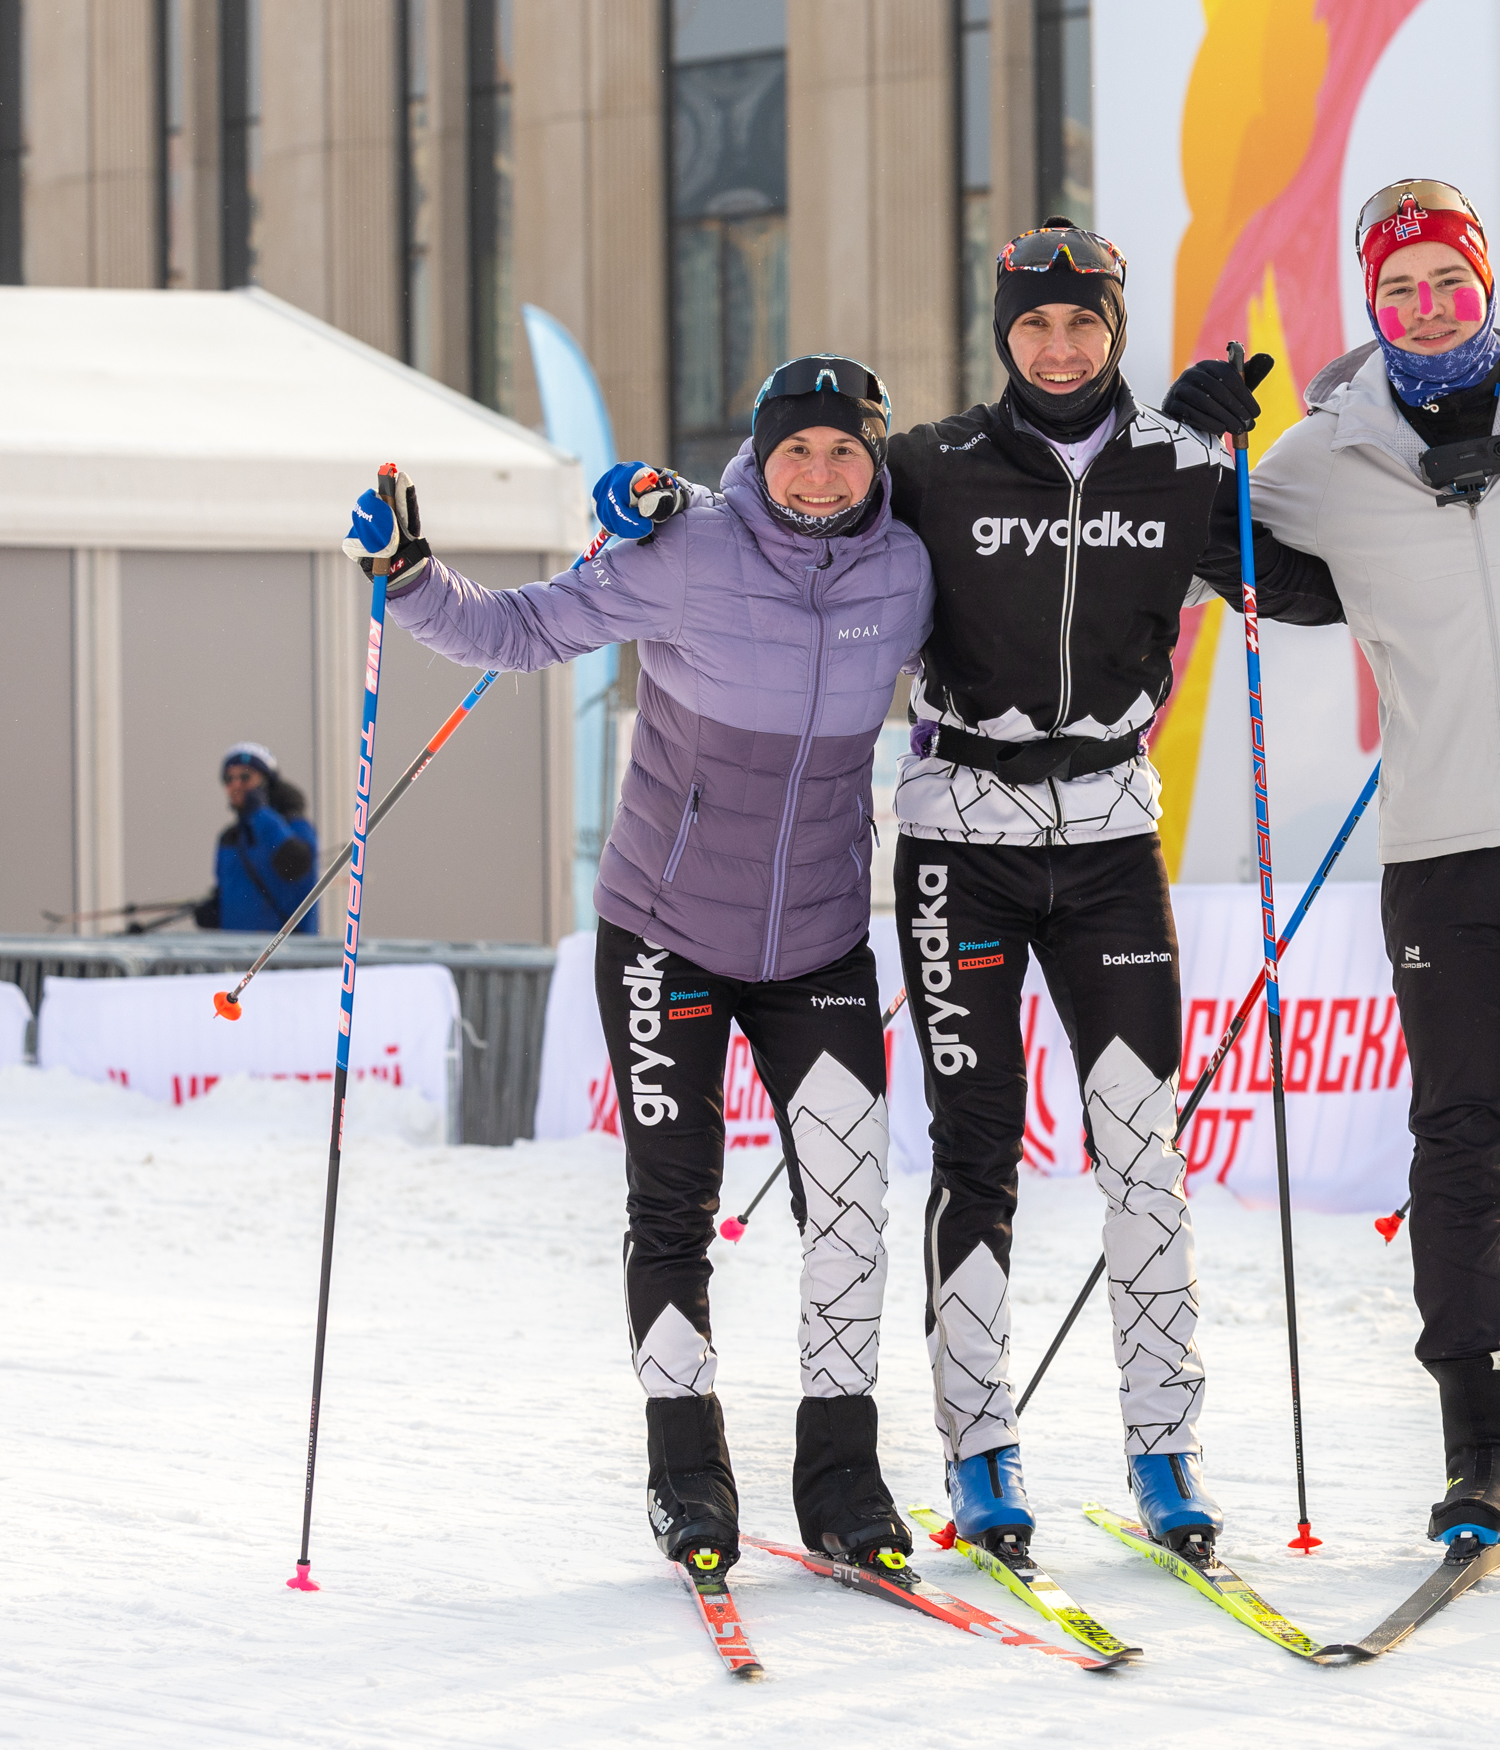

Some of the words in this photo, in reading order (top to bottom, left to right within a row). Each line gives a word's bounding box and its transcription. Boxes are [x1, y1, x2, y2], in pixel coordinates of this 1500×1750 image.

[972, 511, 1165, 556] gryadka
[838, 624, 879, 640] MOAX
[959, 940, 1000, 951] Stimium
[962, 956, 1002, 967] RUNDAY
[1102, 951, 1172, 965] Baklazhan
[911, 864, 978, 1077] gryadka
[670, 990, 709, 1001] Stimium
[672, 1007, 711, 1017] RUNDAY
[975, 1549, 993, 1573] FLASH
[1158, 1551, 1179, 1576] FLASH
[832, 1563, 860, 1584] STC
